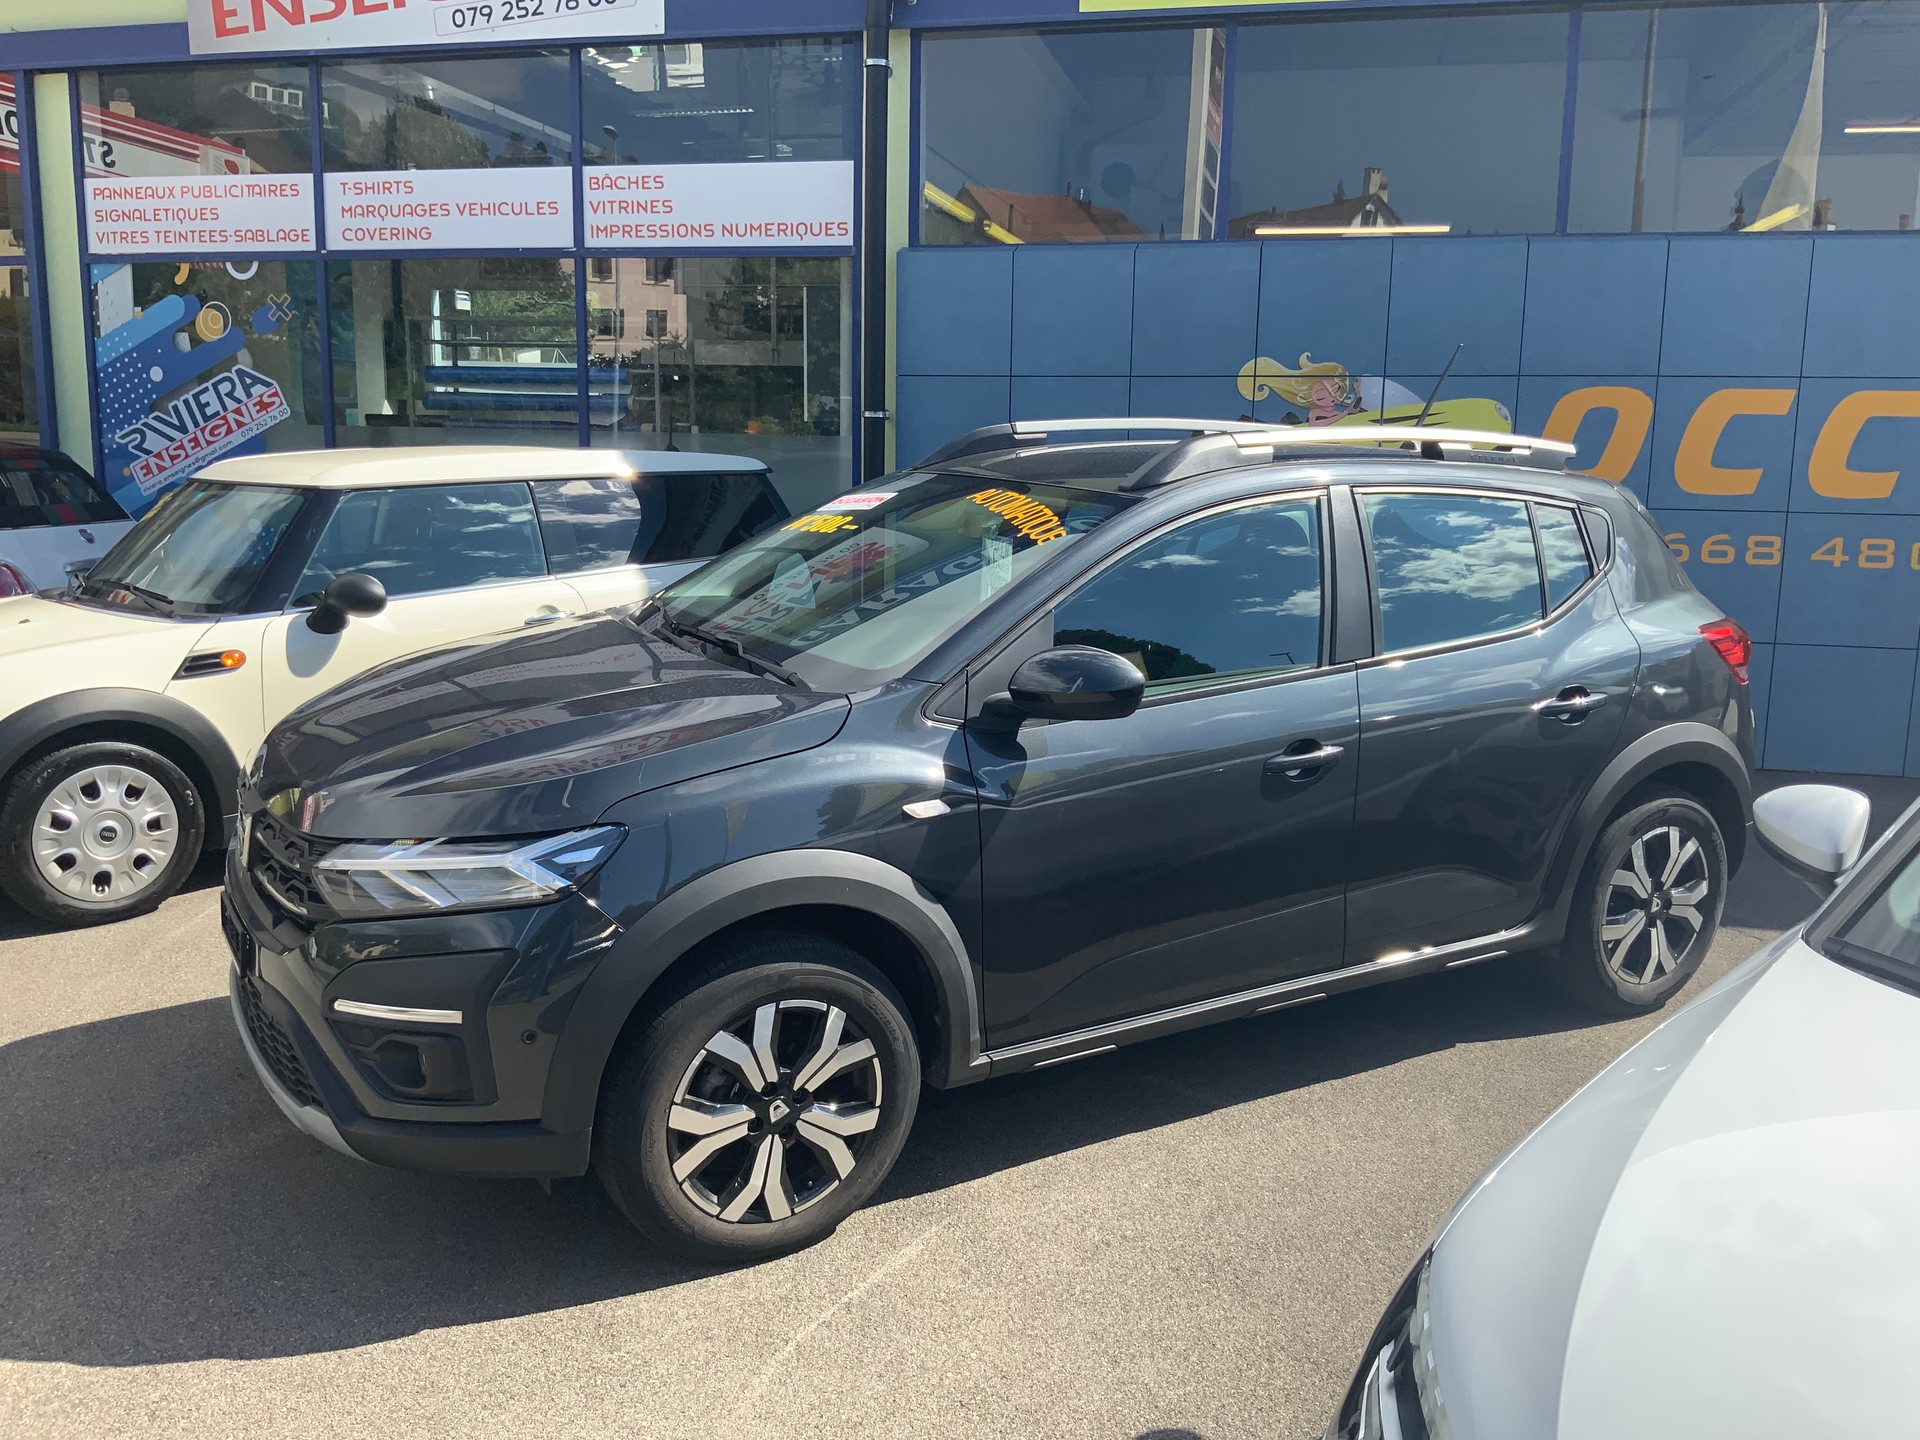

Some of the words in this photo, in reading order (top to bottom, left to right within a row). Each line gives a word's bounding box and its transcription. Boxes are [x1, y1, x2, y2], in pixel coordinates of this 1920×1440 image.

[452, 5, 493, 28] 079
[502, 0, 544, 22] 252
[93, 186, 177, 201] PANNEAUX
[180, 183, 300, 200] PUBLICITAIRES
[340, 181, 414, 196] T-SHIRTS
[588, 174, 665, 191] BÂCHES
[95, 207, 219, 223] SIGNALETIQUES
[341, 203, 451, 221] MARQUAGES
[457, 201, 559, 217] VEHICULES
[588, 199, 674, 215] VITRINES
[95, 231, 151, 245] VITRES
[154, 228, 311, 244] TEINTEES-SABLAGE
[342, 226, 432, 242] COVERING
[589, 223, 715, 240] IMPRESSIONS
[720, 221, 849, 241] NUMERIQUES
[118, 367, 275, 456] RIVIERA
[134, 388, 282, 484] ENSEIGNES
[142, 440, 234, 493] riviera.enseignes@gmail.com
[240, 425, 255, 438] 079
[255, 418, 269, 431] 252
[269, 413, 279, 424] 76
[278, 407, 289, 418] 00
[965, 488, 1068, 546] AUTOMATIQUE
[1810, 537, 1920, 570] 48
